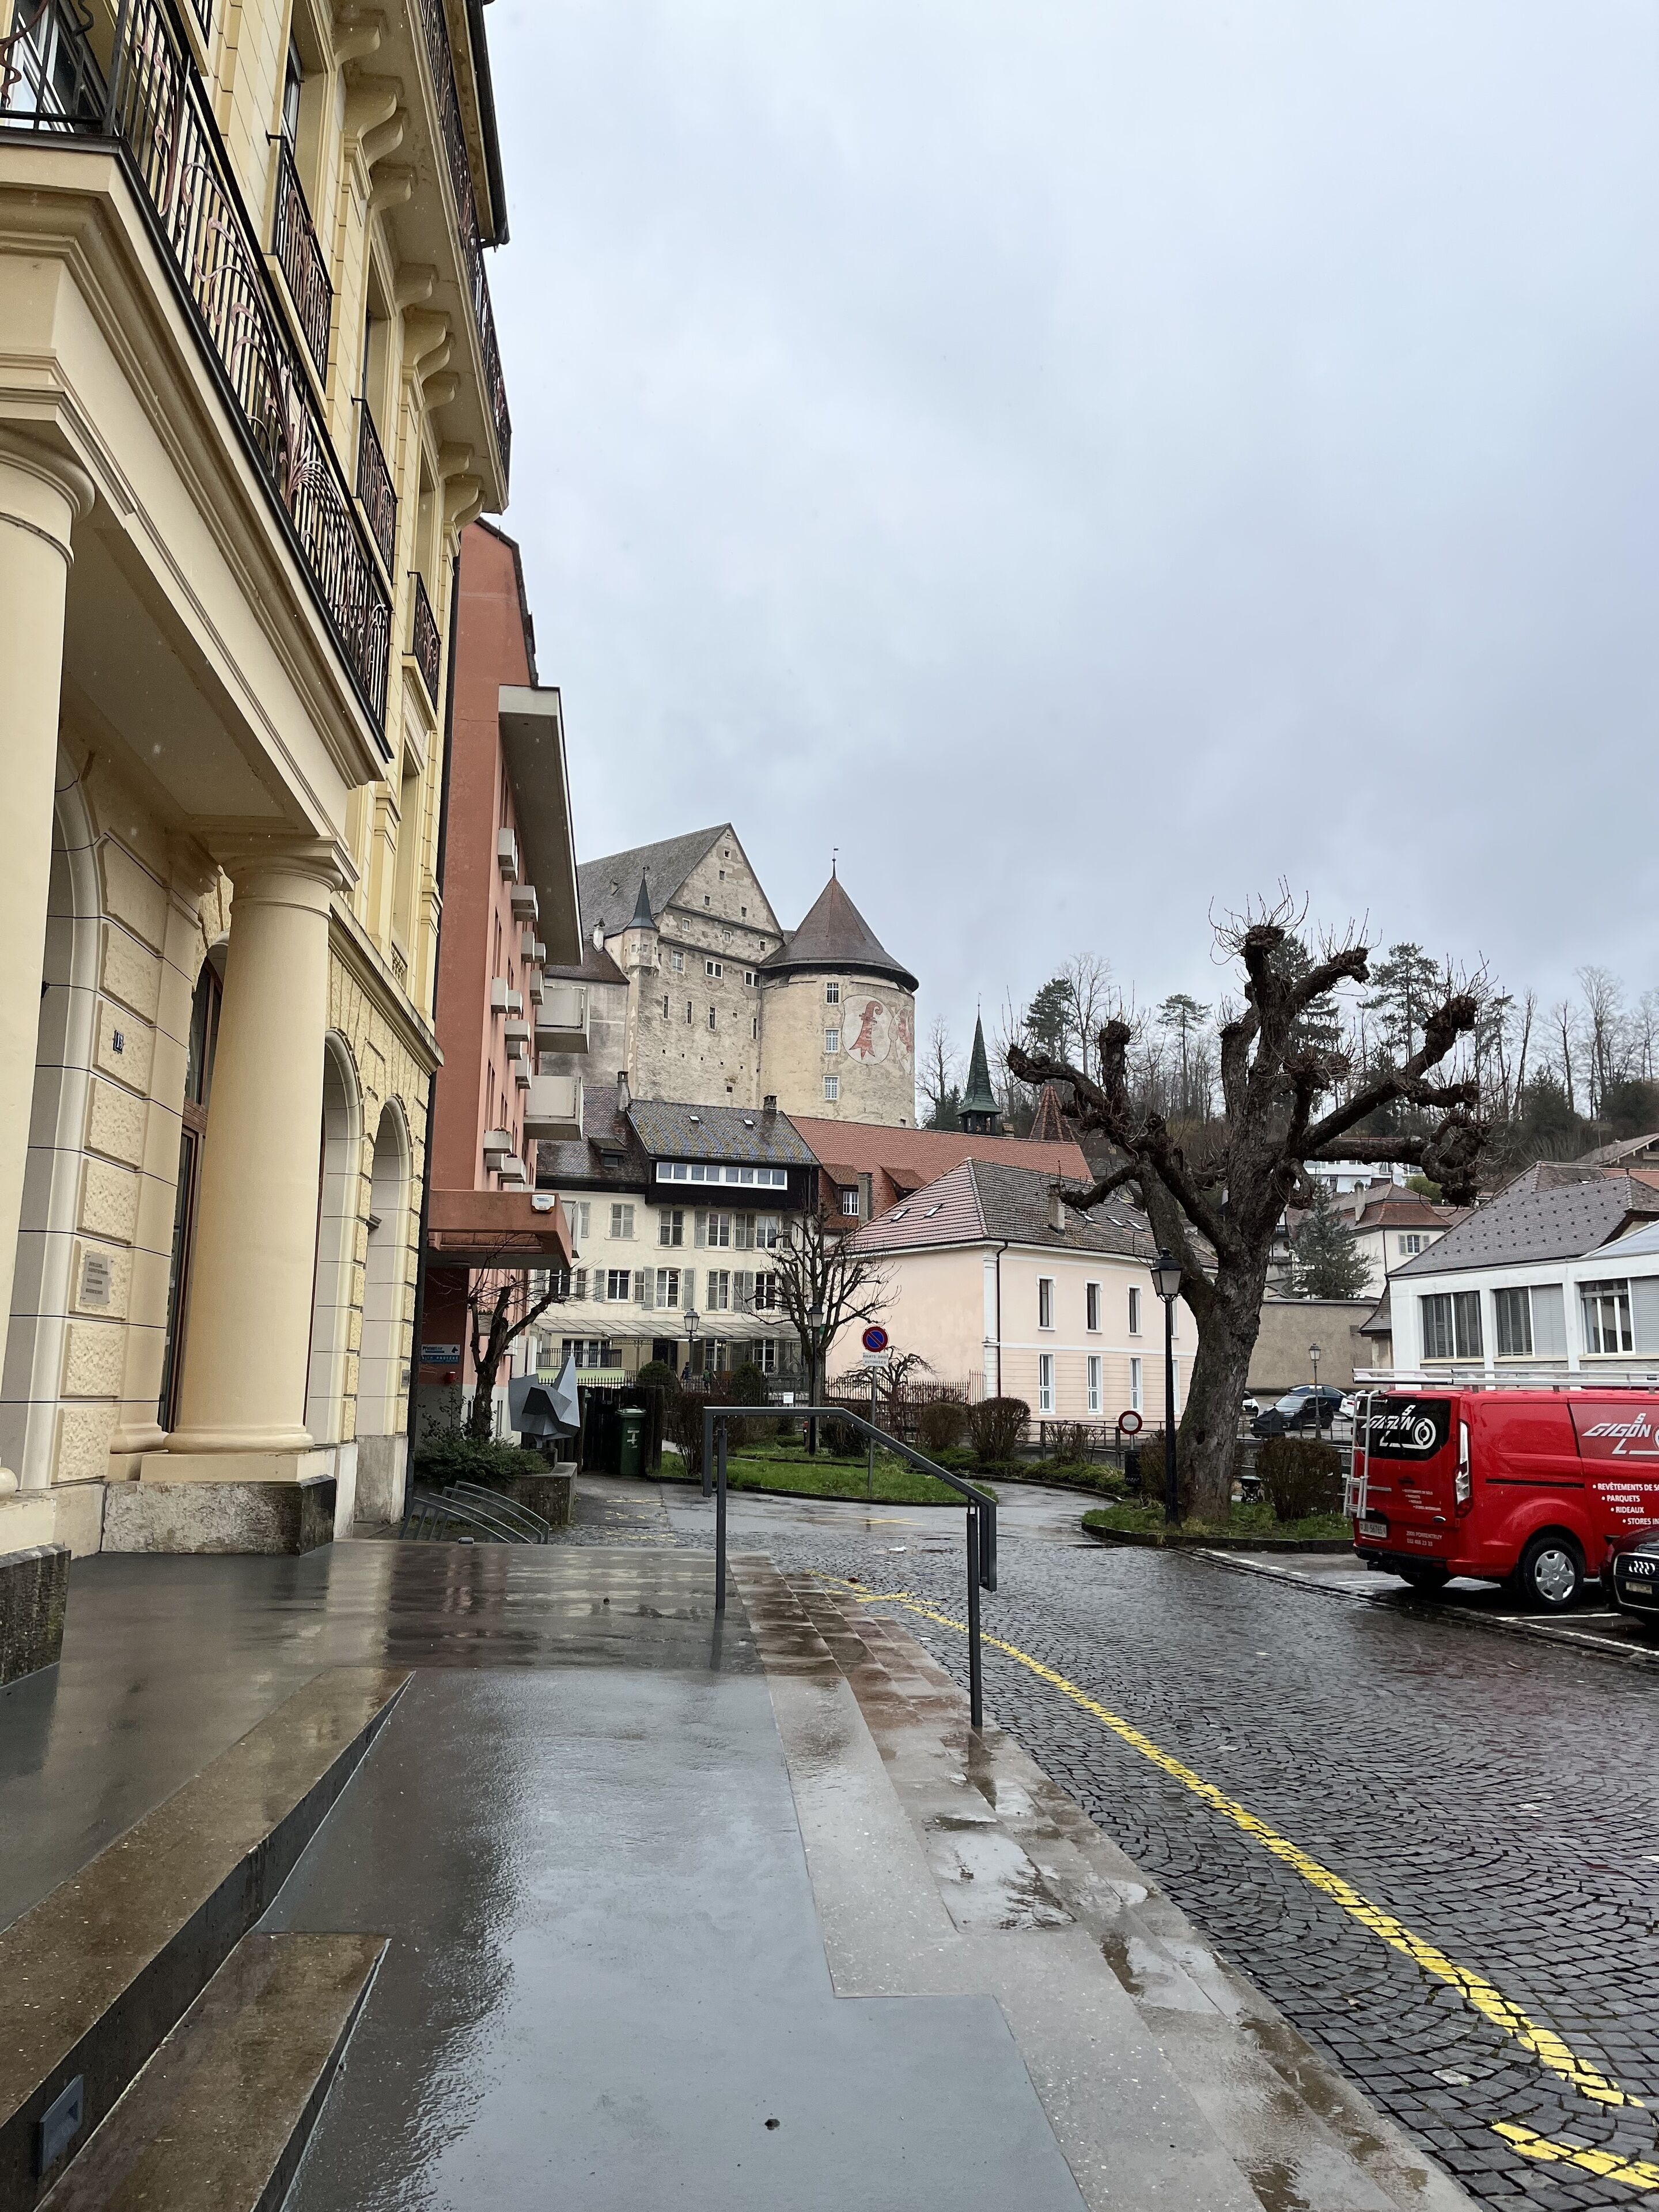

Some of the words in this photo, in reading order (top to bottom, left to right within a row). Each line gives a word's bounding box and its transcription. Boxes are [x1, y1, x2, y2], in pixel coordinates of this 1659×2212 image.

[1581, 1423, 1652, 1438] GIGON
[1597, 1482, 1643, 1491] REVÊTEMENTS
[1607, 1495, 1641, 1503] PARQUETS
